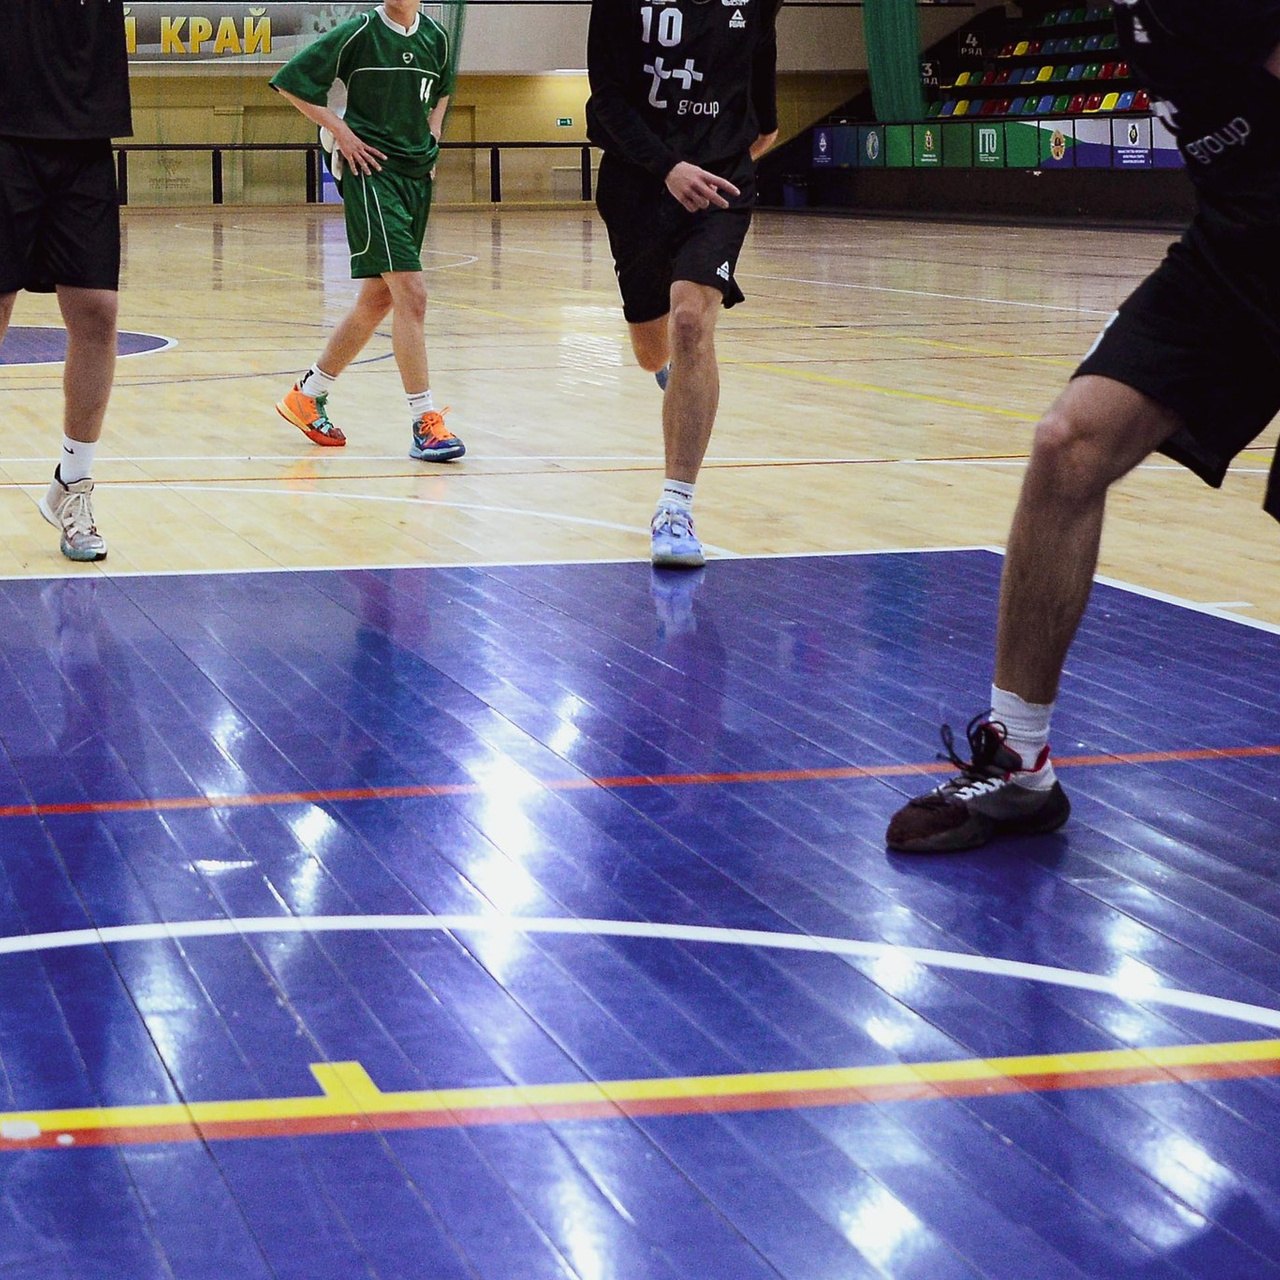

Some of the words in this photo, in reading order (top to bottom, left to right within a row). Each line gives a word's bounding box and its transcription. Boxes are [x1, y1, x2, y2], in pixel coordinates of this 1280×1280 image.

[160, 7, 272, 54] КРАЙ
[640, 6, 683, 47] 10
[966, 33, 978, 47] 4
[961, 48, 983, 56] РЯД
[921, 62, 933, 77] 3
[677, 100, 720, 118] group
[1186, 116, 1251, 164] group
